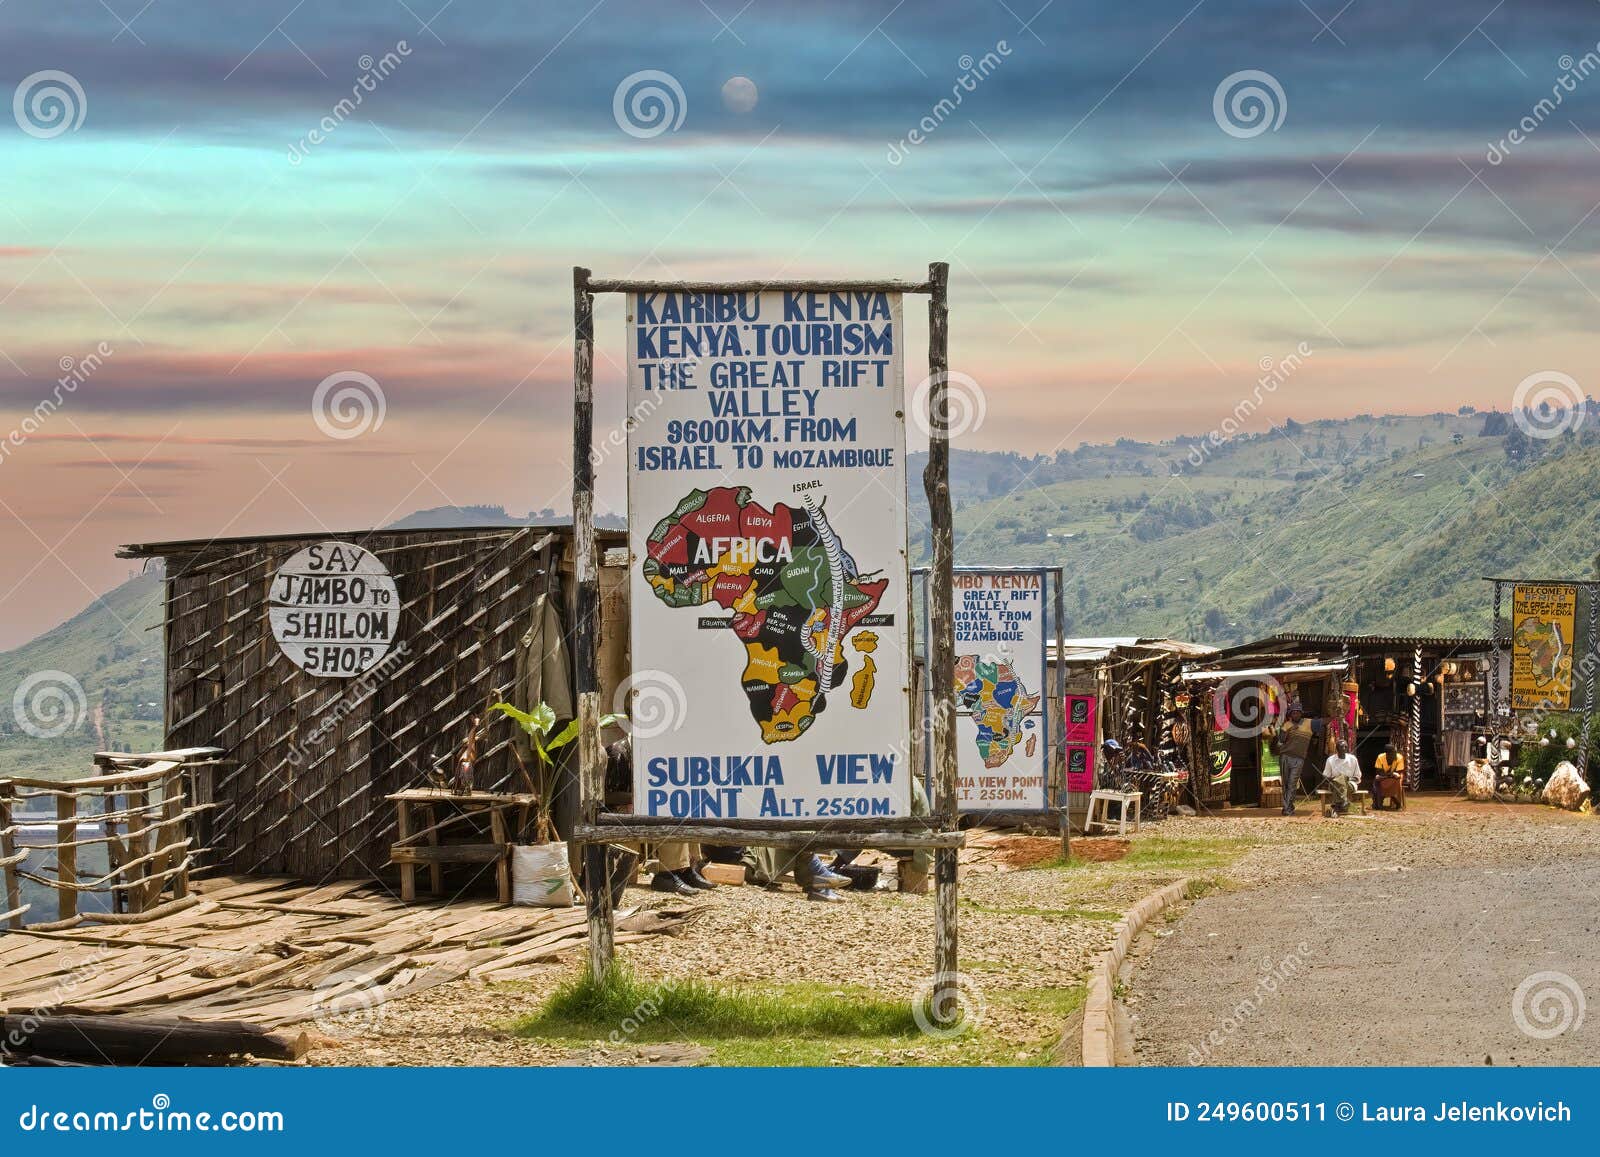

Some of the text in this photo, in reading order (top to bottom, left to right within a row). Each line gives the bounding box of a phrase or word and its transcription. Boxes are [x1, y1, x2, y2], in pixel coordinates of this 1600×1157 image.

[637, 291, 892, 324] KARIBU KENYA
[638, 360, 890, 390] THE GREAT RIFT
[708, 390, 820, 417] VALLEY
[785, 418, 856, 442] FROM
[638, 445, 894, 471] ISRAEL TO MOZAMBIQUE
[792, 480, 823, 492] ISRAEL
[696, 514, 730, 522] ALGERIA
[747, 516, 772, 527] LIBYA
[694, 536, 794, 564] AFRICA
[309, 545, 366, 572] SAY
[670, 566, 688, 576] MALI
[722, 564, 742, 572] NIGER
[786, 566, 810, 578] SUDAN
[716, 583, 742, 591] NIGERIA
[952, 575, 1040, 589] MBO KENYA
[278, 574, 390, 605] JAMBO TO
[964, 590, 1039, 600] GREAT RIFT
[1518, 586, 1561, 594] WELCOME
[963, 601, 1008, 610] VALLEY
[954, 611, 1032, 620] 00KM. FROM
[282, 612, 389, 640] SHALOM
[1004, 622, 1018, 630] TO
[956, 631, 1024, 641] OZAMBIQUE
[303, 647, 374, 674] SHOP
[746, 684, 770, 692] NAMIBIA
[648, 754, 895, 786] SUBUKIA VIEW
[979, 776, 1006, 788] VIEW
[1012, 776, 1044, 788] POINT
[956, 790, 974, 800] LT.
[648, 788, 742, 818] POINT
